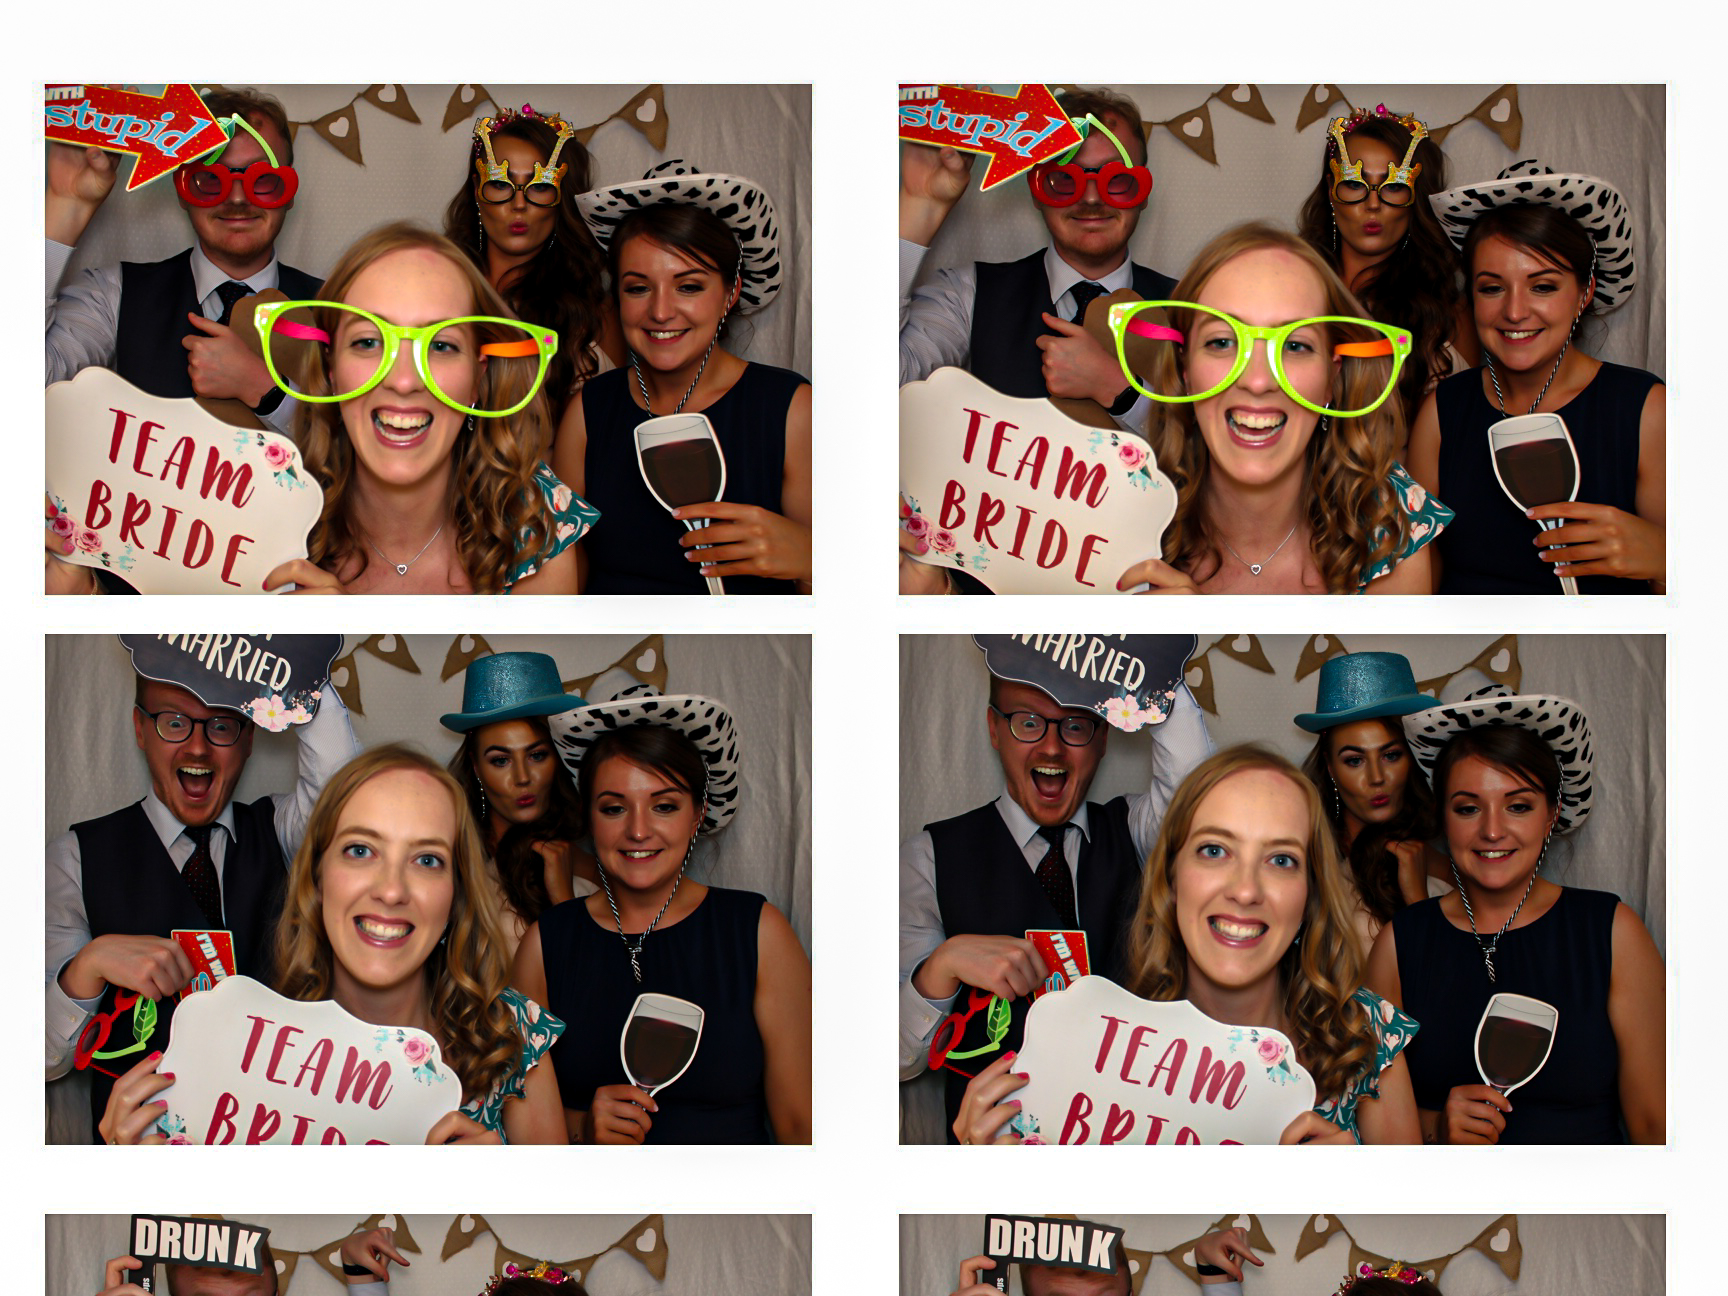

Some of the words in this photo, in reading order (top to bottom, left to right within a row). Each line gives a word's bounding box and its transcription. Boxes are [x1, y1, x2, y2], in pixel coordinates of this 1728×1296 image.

[45, 99, 213, 158] stupid
[899, 99, 1067, 158] stupid
[108, 407, 254, 509] TEAM
[962, 407, 1108, 509] TEAM
[84, 479, 255, 587] BRIDE
[938, 479, 1109, 587] BRIDE
[240, 1015, 393, 1110] TEAM
[1094, 1015, 1247, 1110] TEAM
